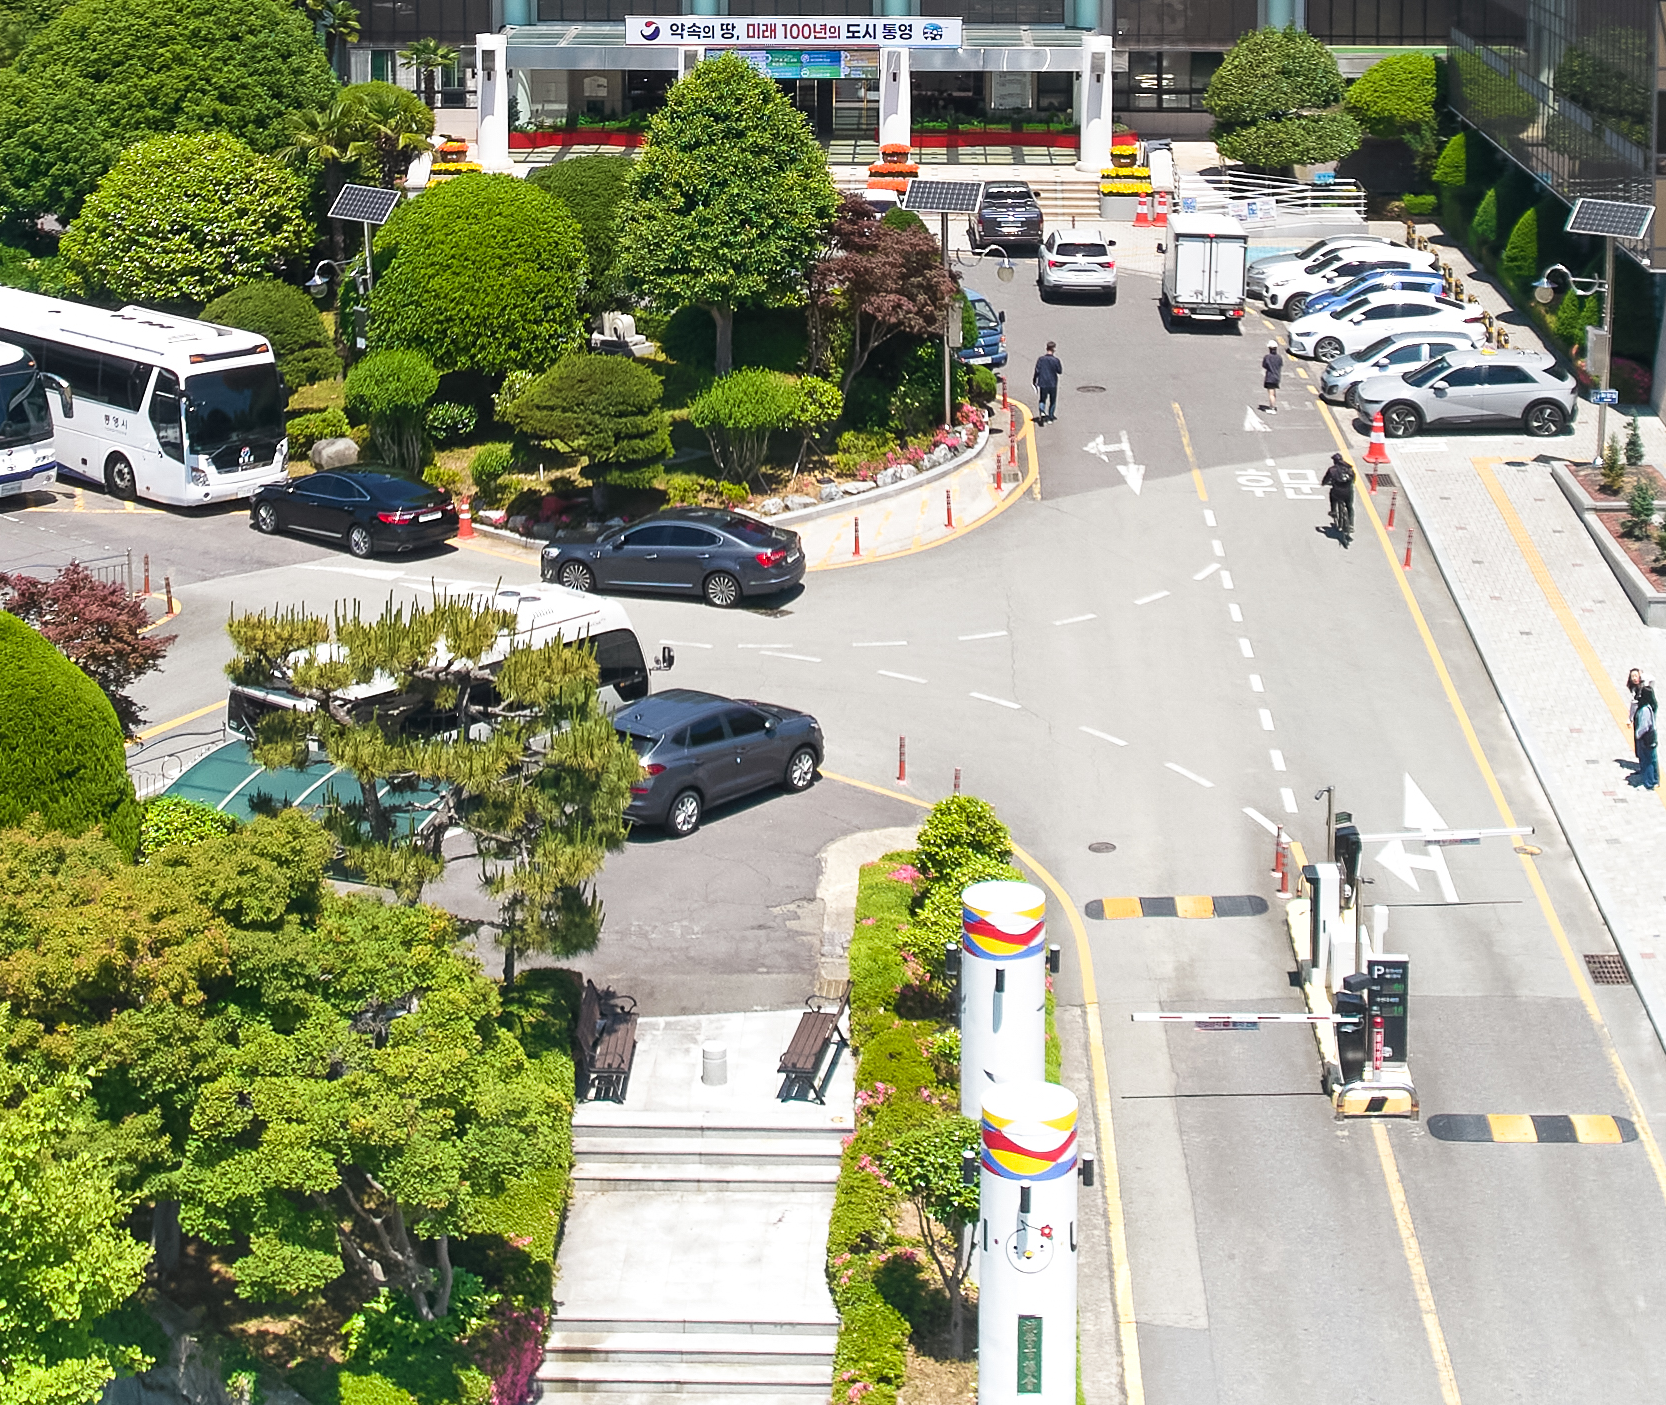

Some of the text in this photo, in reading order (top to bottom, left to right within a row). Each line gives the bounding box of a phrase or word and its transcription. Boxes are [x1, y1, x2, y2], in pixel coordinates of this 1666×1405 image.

[669, 22, 913, 41] 약속의 땅, 미래 100년의 도시 통영
[1235, 468, 1326, 500] 후문
[1373, 965, 1385, 979] P
